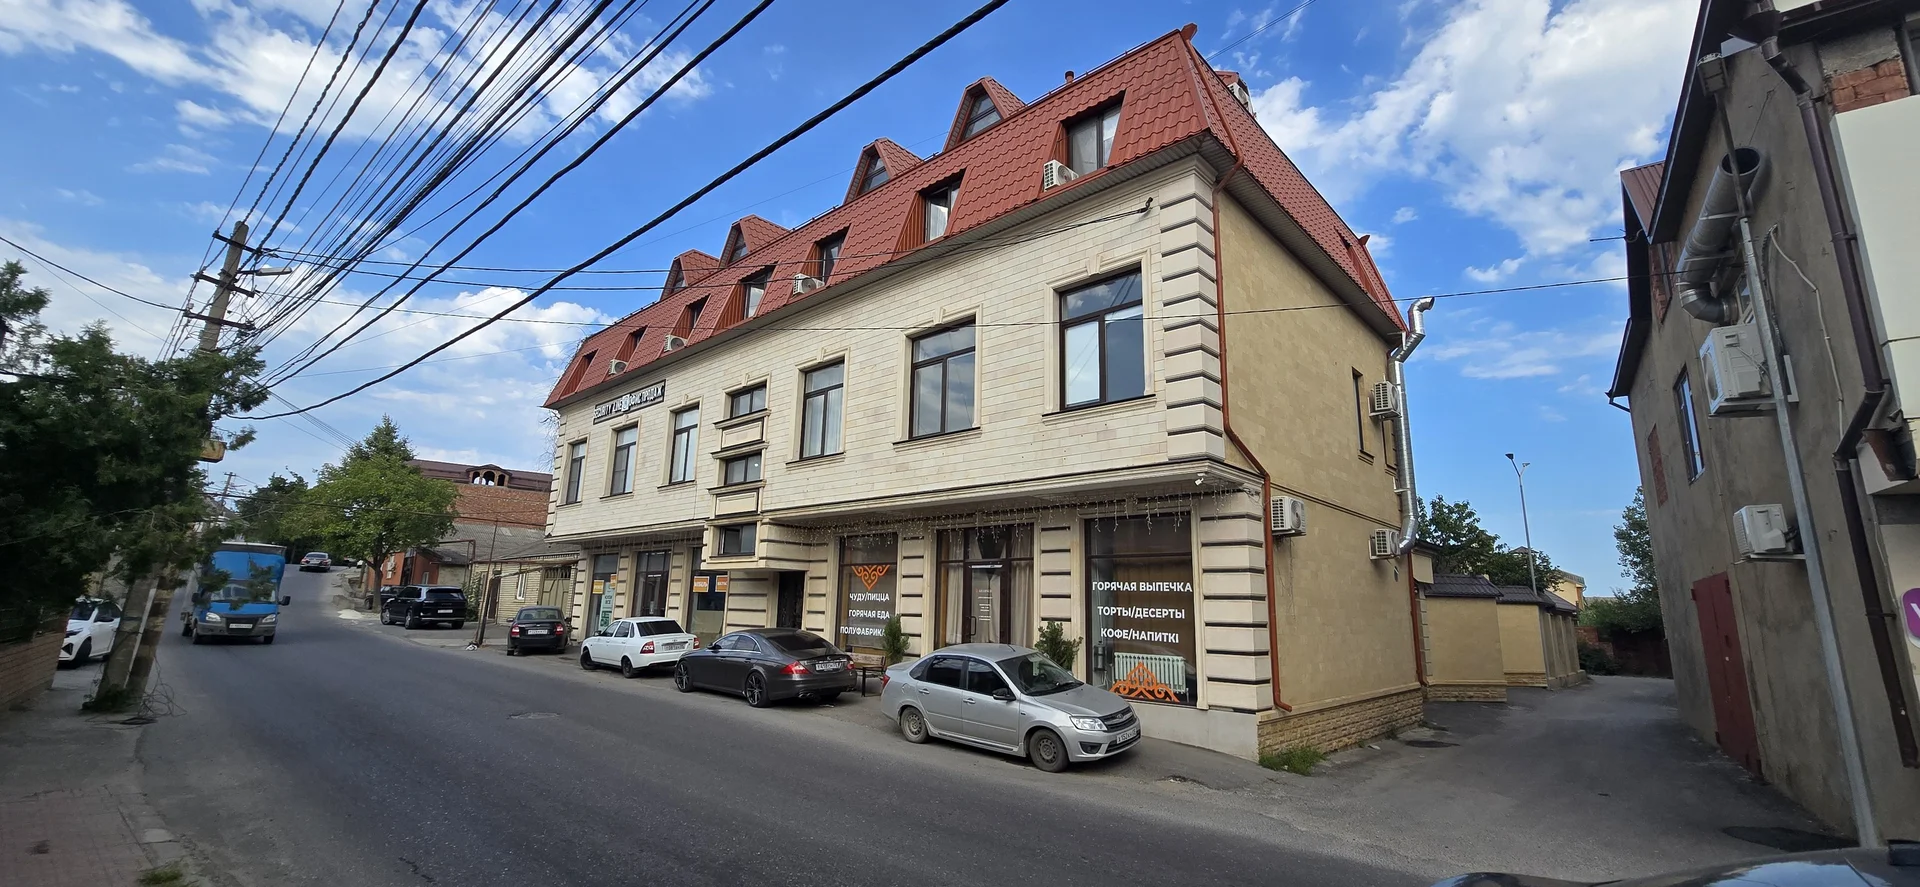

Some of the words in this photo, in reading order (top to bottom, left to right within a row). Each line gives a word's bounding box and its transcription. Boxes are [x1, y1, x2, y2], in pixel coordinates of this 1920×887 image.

[1092, 581, 1137, 591] ГОРЯЧАЯ
[1139, 582, 1193, 592] ВЫПЕЧКА
[849, 592, 890, 602] ЧУДУ/ПИЦЦА
[848, 609, 876, 618] ГОРЯЧАЯ
[876, 610, 890, 620] ЕДА
[1097, 606, 1185, 619] ТОРТЫ/ДЕСЕРТЫ
